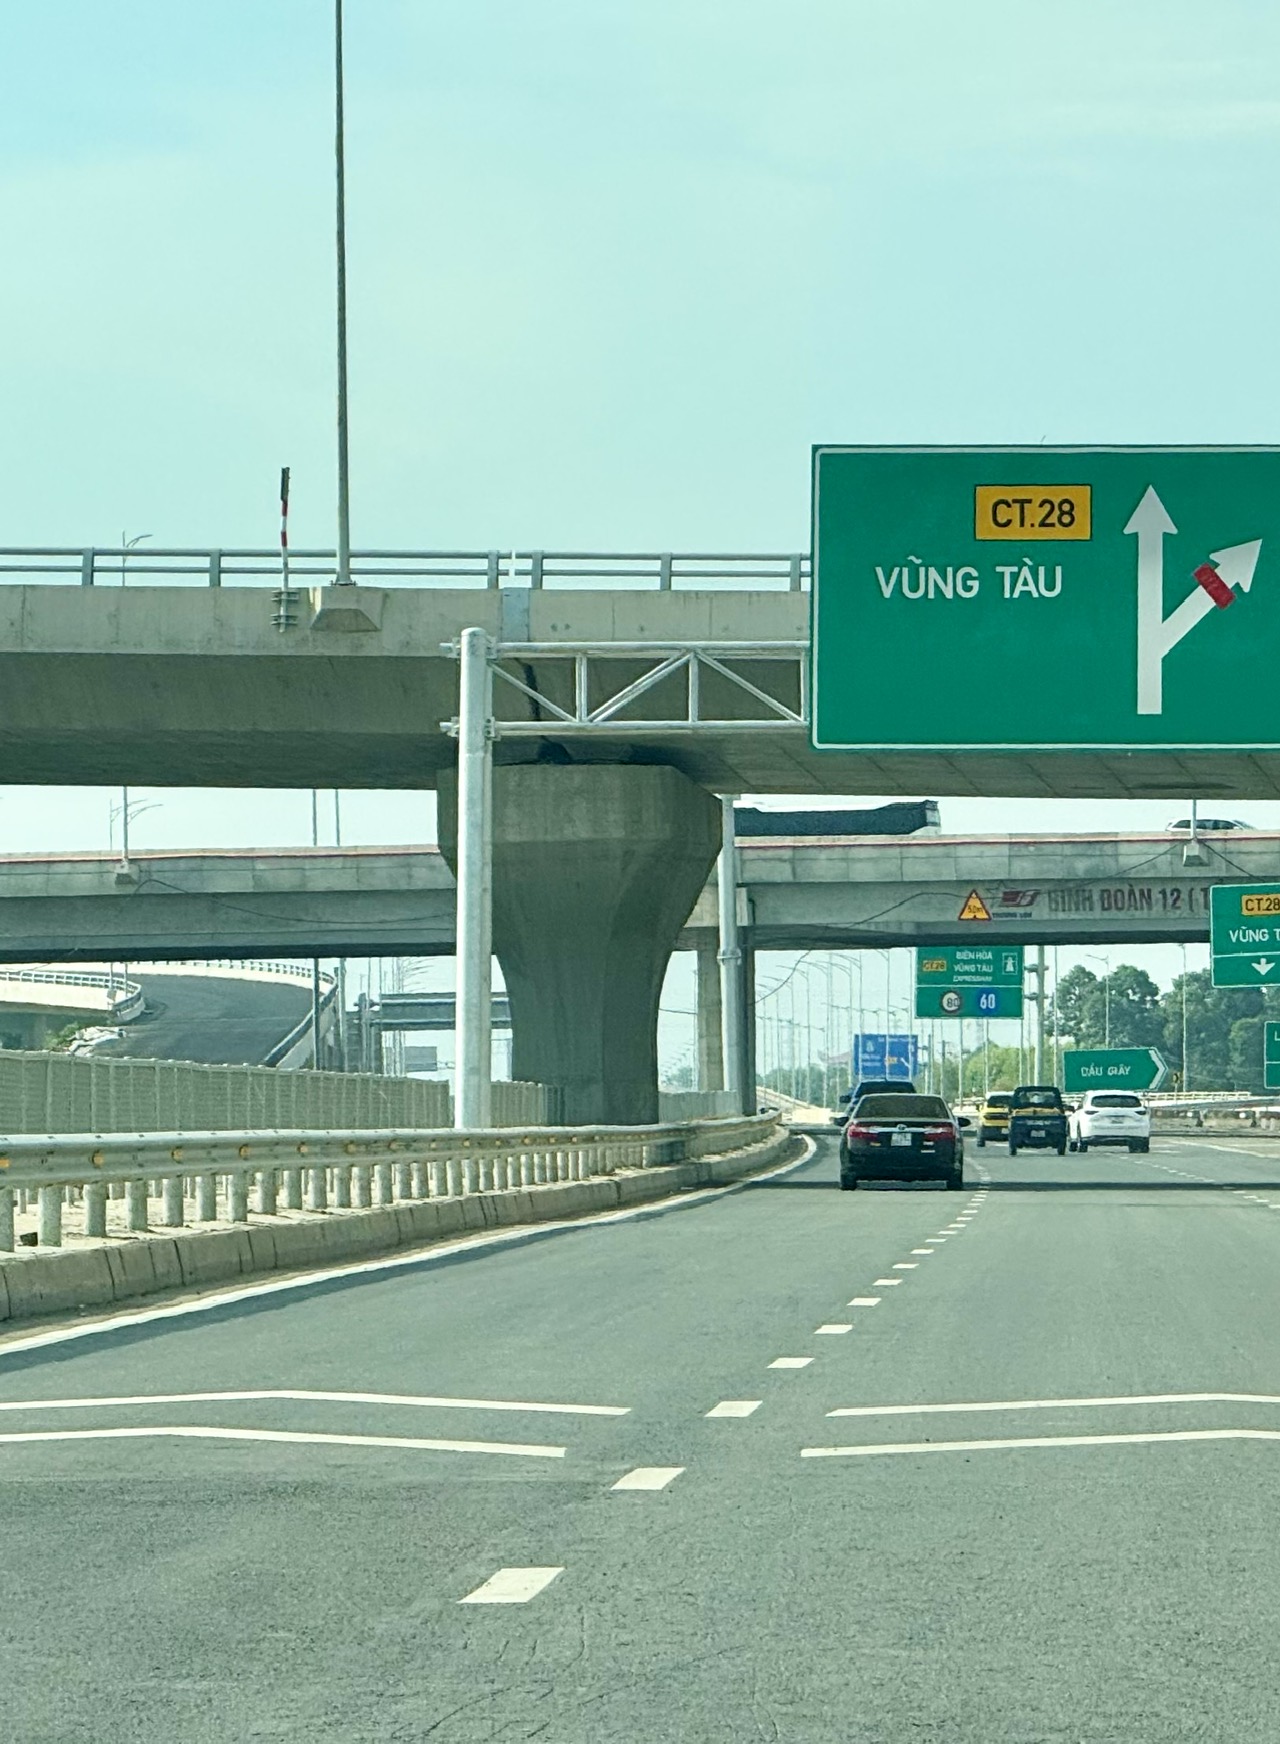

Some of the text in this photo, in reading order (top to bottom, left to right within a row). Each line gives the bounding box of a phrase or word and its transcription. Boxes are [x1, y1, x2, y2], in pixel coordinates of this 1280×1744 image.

[991, 498, 1075, 528] CT.28
[875, 555, 1062, 599] VŨNG TÀU
[1159, 888, 1182, 910] 12
[1245, 897, 1280, 912] CT.28
[1229, 925, 1270, 943] VŨNG
[980, 993, 996, 1009] 60
